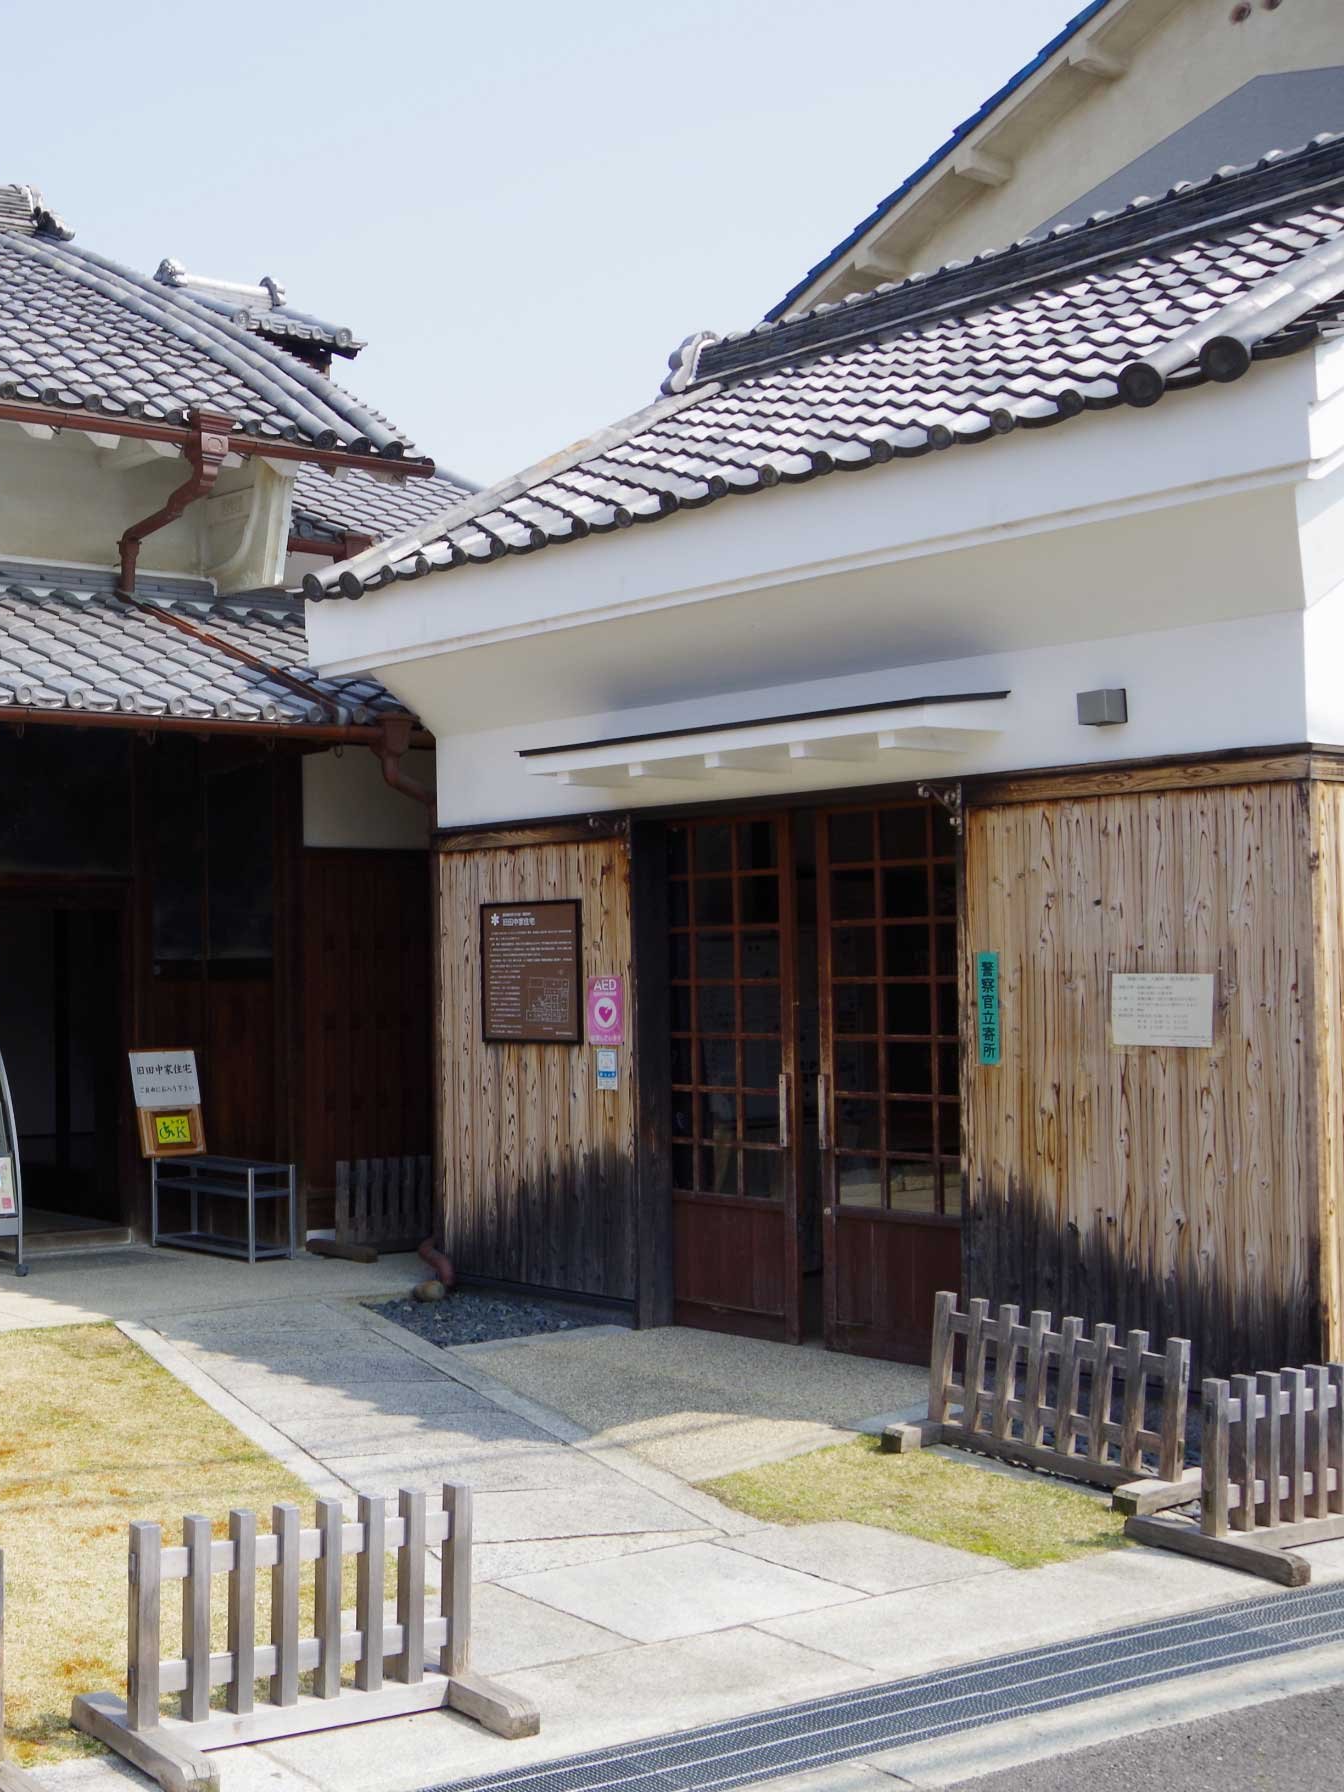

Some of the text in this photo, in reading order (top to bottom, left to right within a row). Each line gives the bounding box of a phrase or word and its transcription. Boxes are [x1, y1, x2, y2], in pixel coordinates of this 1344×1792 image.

[594, 979, 617, 991] AED
[981, 961, 996, 1058] 警察官立寄所
[136, 1063, 193, 1075] 旧田中家住宅
